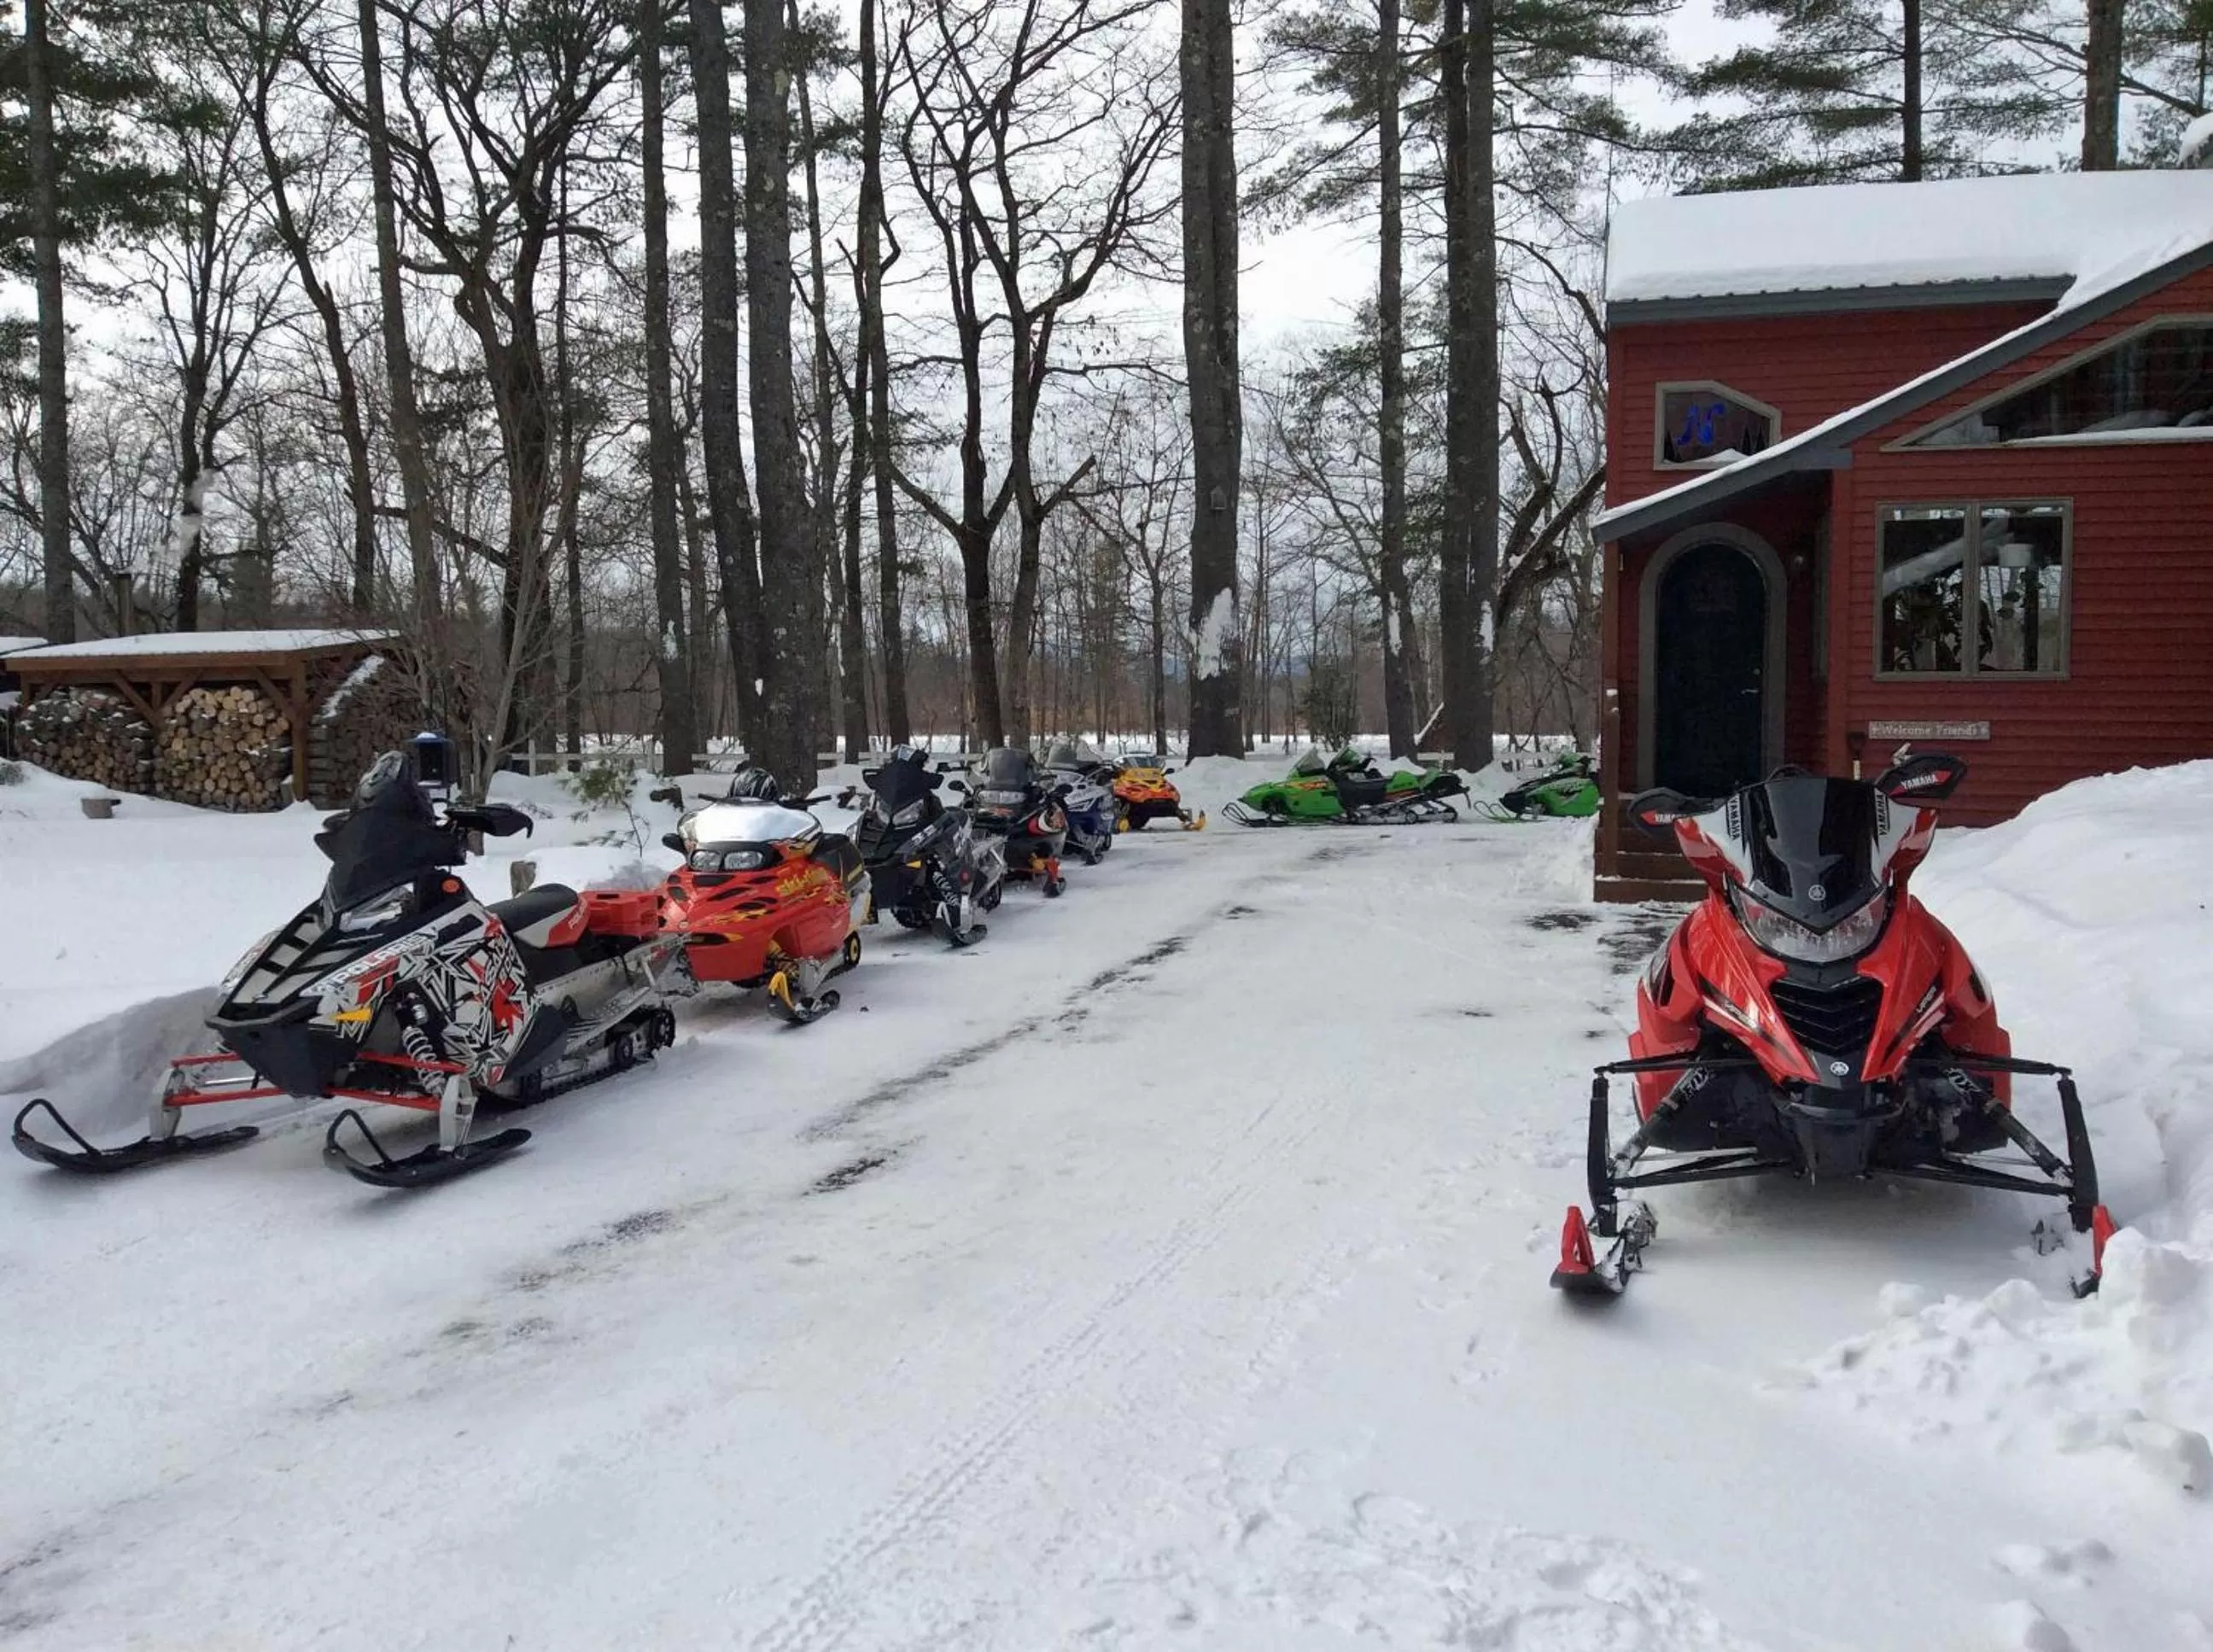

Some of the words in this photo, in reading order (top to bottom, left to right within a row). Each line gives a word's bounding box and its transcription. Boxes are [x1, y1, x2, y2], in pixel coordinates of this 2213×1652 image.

[1882, 724, 1931, 736] Welcome
[1901, 773, 1938, 790] YAMAHA
[1655, 812, 1684, 825] YAMA
[1728, 797, 1742, 840] YAMAHA
[1877, 794, 1889, 836] YAMAHA
[333, 934, 429, 986] POLARIS
